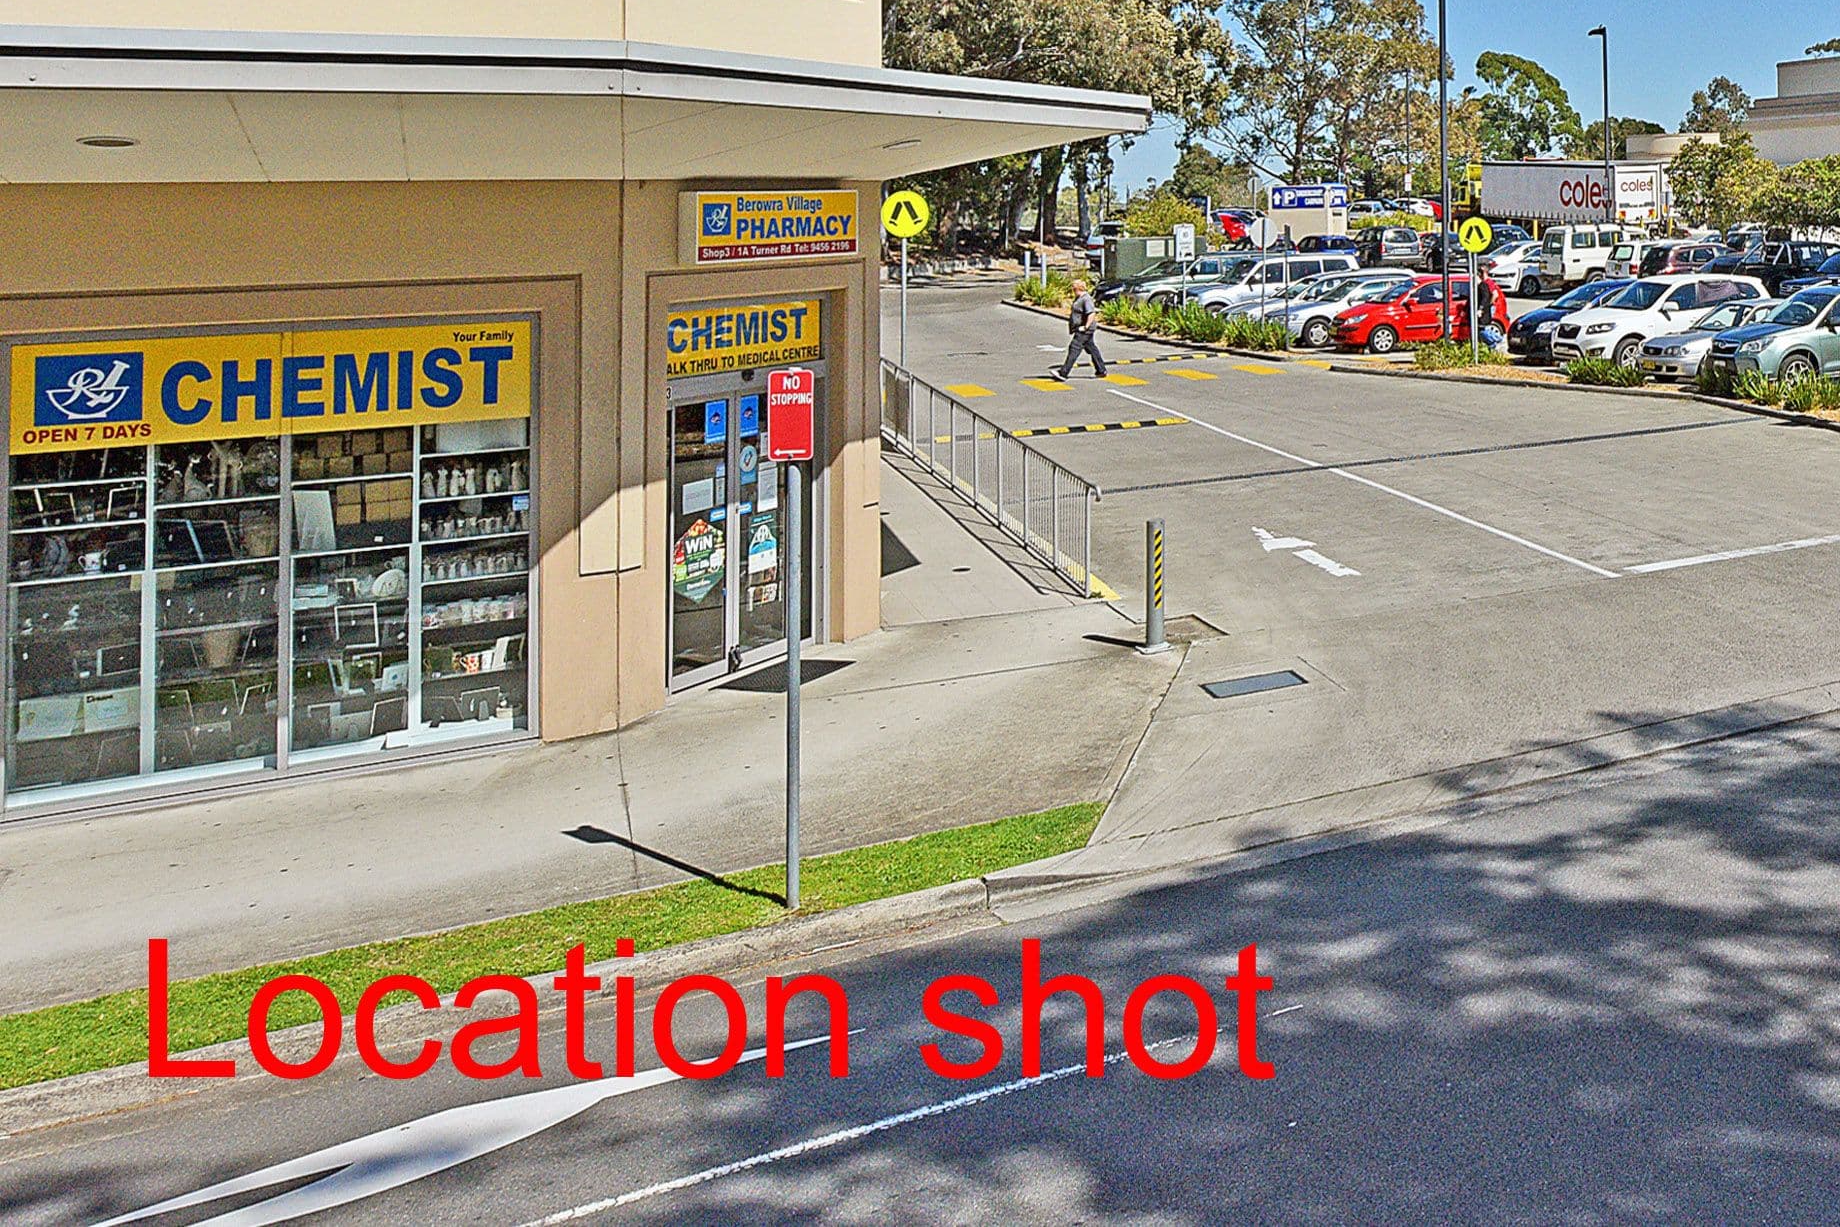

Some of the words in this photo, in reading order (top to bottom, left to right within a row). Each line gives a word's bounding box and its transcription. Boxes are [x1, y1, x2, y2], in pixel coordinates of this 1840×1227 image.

[1559, 174, 1612, 209] coles
[1620, 179, 1653, 192] coles
[737, 197, 783, 212] Berowra
[787, 196, 822, 213] Village
[736, 215, 852, 240] PHARMACY
[702, 247, 730, 259] Shop3
[737, 247, 748, 256] 1A
[751, 246, 778, 255] Turner
[780, 244, 791, 254] Rd
[794, 243, 809, 253] Tel:
[810, 242, 829, 252] 9456
[831, 241, 849, 251] 2196
[453, 331, 476, 343] Your
[479, 330, 514, 344] Family
[667, 307, 808, 353] CHEMIST
[667, 363, 687, 376] ALK
[690, 358, 718, 372] THRU
[721, 356, 734, 368] TO
[737, 352, 780, 366] MEDICAL
[782, 345, 819, 360] CENTRE
[160, 346, 514, 426] CHEMIST
[783, 376, 800, 390] NO
[771, 393, 812, 405] STOPPING
[23, 429, 78, 444] OPEN
[85, 427, 96, 440] 7
[102, 423, 152, 439] DAYS
